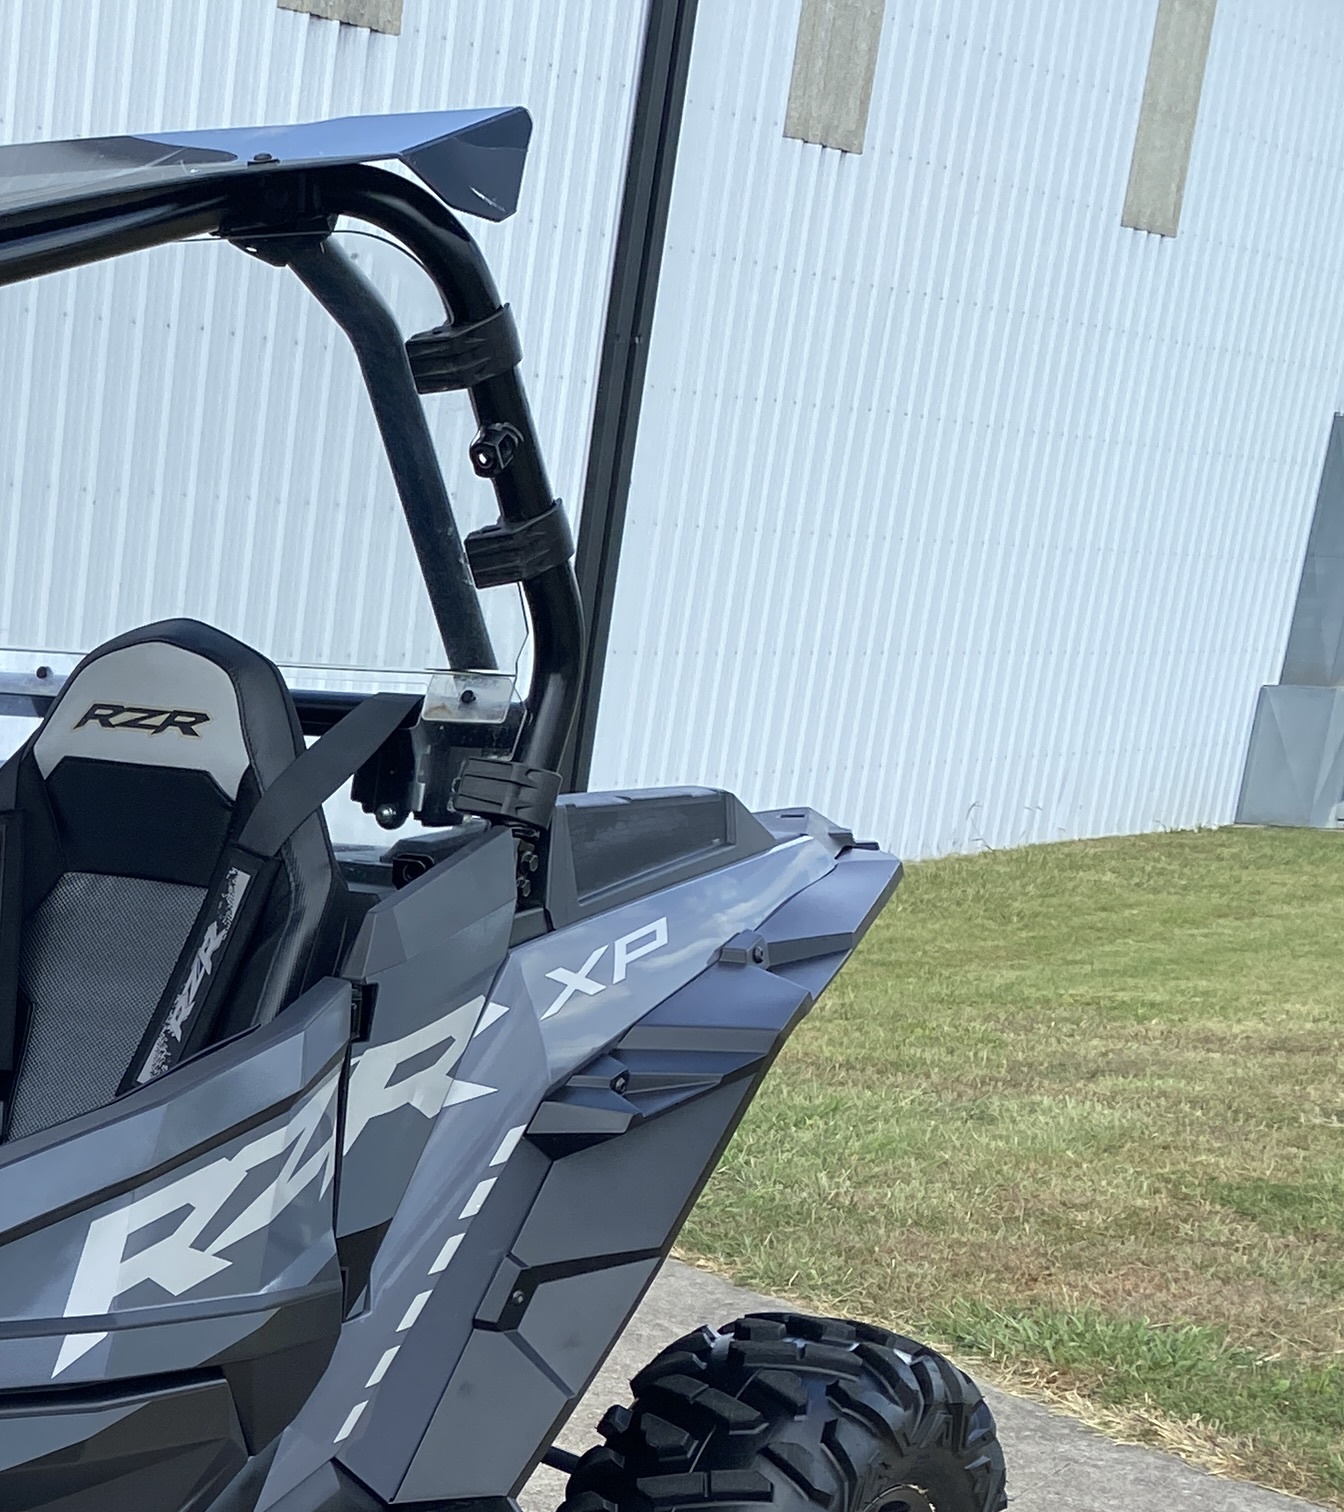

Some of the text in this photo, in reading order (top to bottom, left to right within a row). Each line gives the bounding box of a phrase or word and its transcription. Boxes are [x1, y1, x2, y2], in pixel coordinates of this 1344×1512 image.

[72, 702, 211, 738] RZR
[168, 920, 228, 1042] RZR
[540, 916, 669, 1021] XP
[52, 994, 510, 1378] RZR
